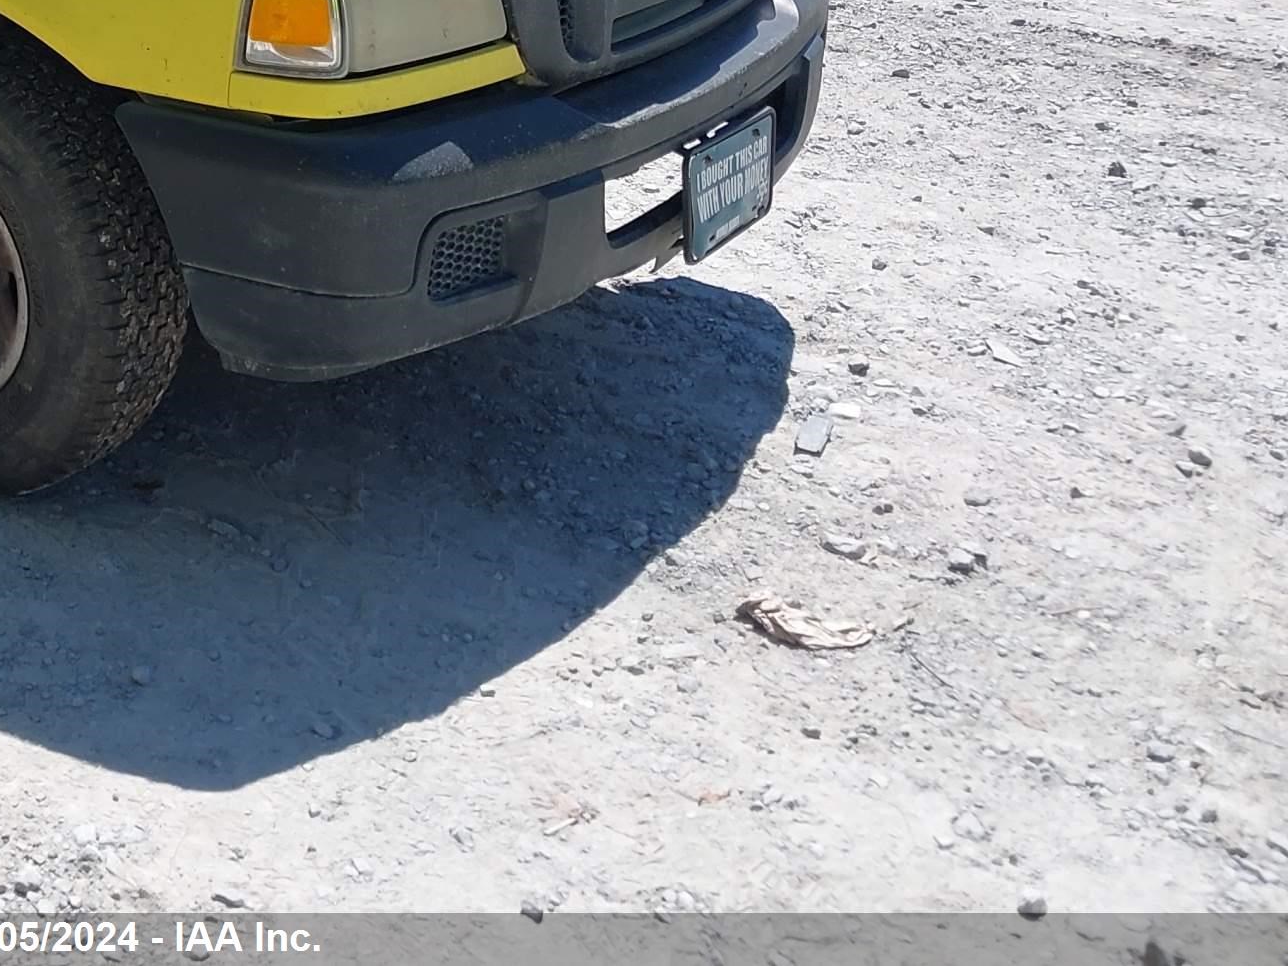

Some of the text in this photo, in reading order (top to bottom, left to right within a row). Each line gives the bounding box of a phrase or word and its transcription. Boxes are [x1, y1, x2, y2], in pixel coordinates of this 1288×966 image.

[697, 136, 768, 193] I BOUGHT THIS CAR
[697, 156, 769, 224] WITH YOUR MONEY
